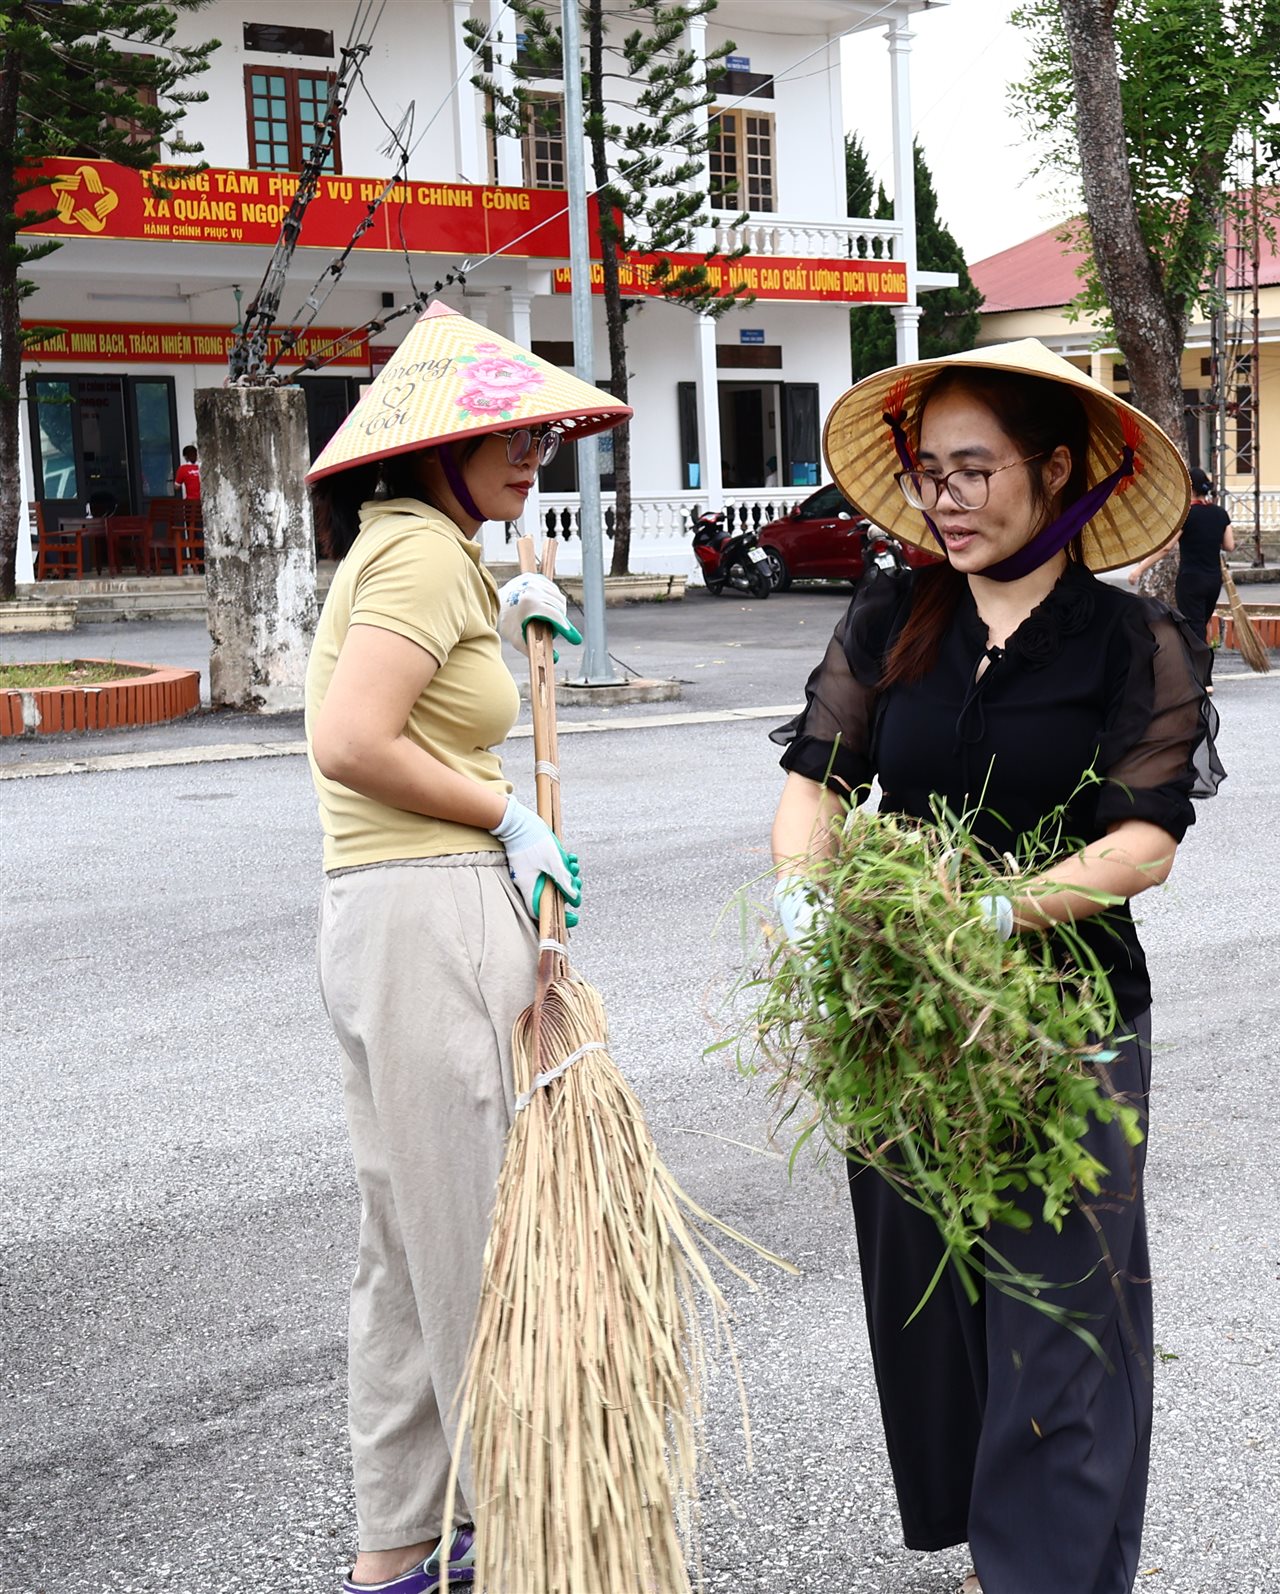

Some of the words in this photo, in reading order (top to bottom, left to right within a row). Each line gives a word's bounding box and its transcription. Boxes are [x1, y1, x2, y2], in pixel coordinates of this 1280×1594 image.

[214, 171, 259, 195] TÂM
[327, 181, 353, 204] VỤ
[360, 179, 412, 204] HÀNH
[417, 185, 473, 208] CHÍNH
[482, 189, 530, 211] CÔNG
[174, 193, 236, 222] QUẢNG
[143, 222, 171, 235] HÀNH
[173, 225, 201, 237] CHÍNH
[204, 228, 229, 240] PHỤC
[231, 230, 243, 241] VỤ
[729, 264, 758, 289] NÂNG
[760, 268, 780, 290] CAO
[782, 262, 807, 291] CHẤT
[809, 268, 841, 295] LƯỢNG
[843, 271, 865, 296] DỊCH
[867, 272, 881, 297] VỤ
[881, 269, 906, 294] CÔNG
[71, 333, 97, 353] MINH
[99, 334, 128, 358] BẠCH,
[129, 331, 160, 354] TRÁCH
[162, 331, 192, 358] NHIỆM
[193, 336, 223, 355] TRONG
